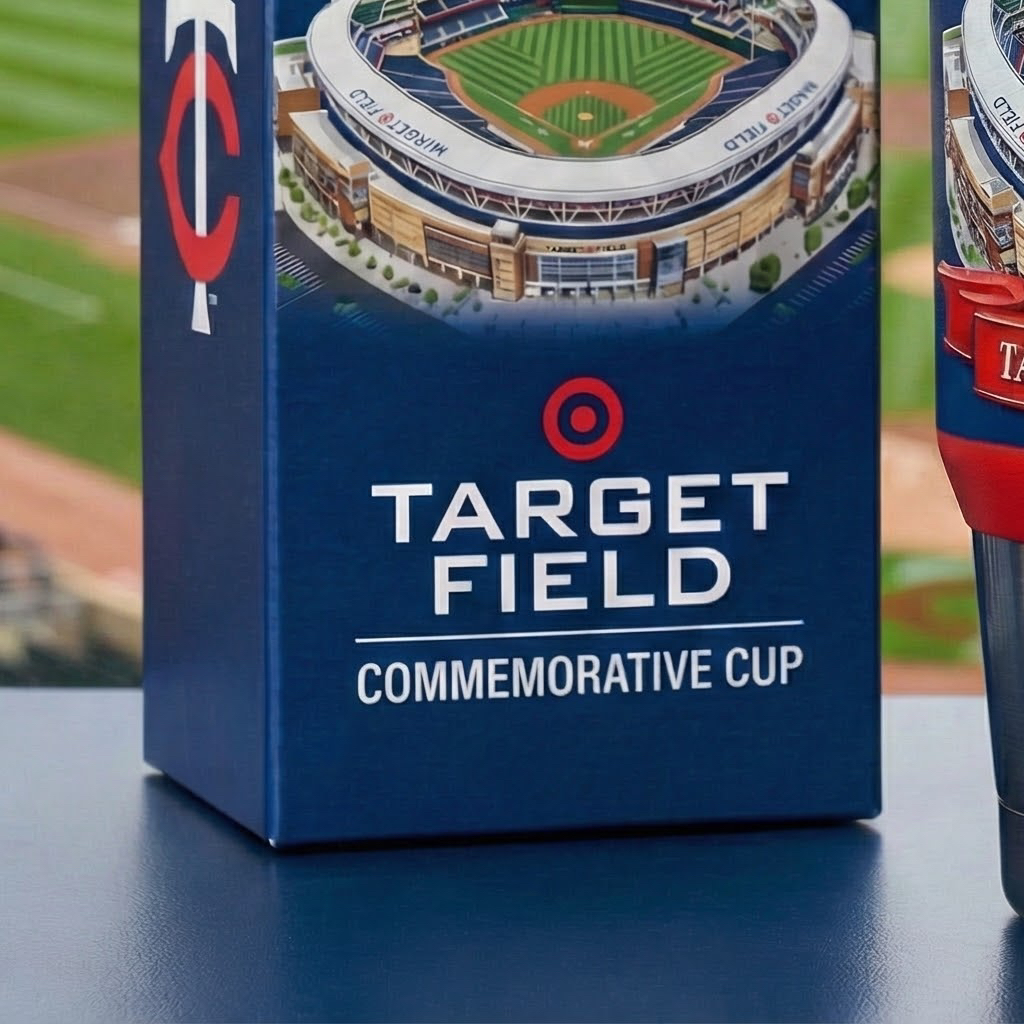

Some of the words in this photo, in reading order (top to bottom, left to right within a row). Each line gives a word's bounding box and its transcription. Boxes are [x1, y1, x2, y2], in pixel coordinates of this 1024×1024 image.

[371, 471, 790, 544] TARGET
[433, 546, 732, 616] FIELD
[356, 648, 713, 705] COMMEMORATIVE
[724, 644, 804, 688] CUP
